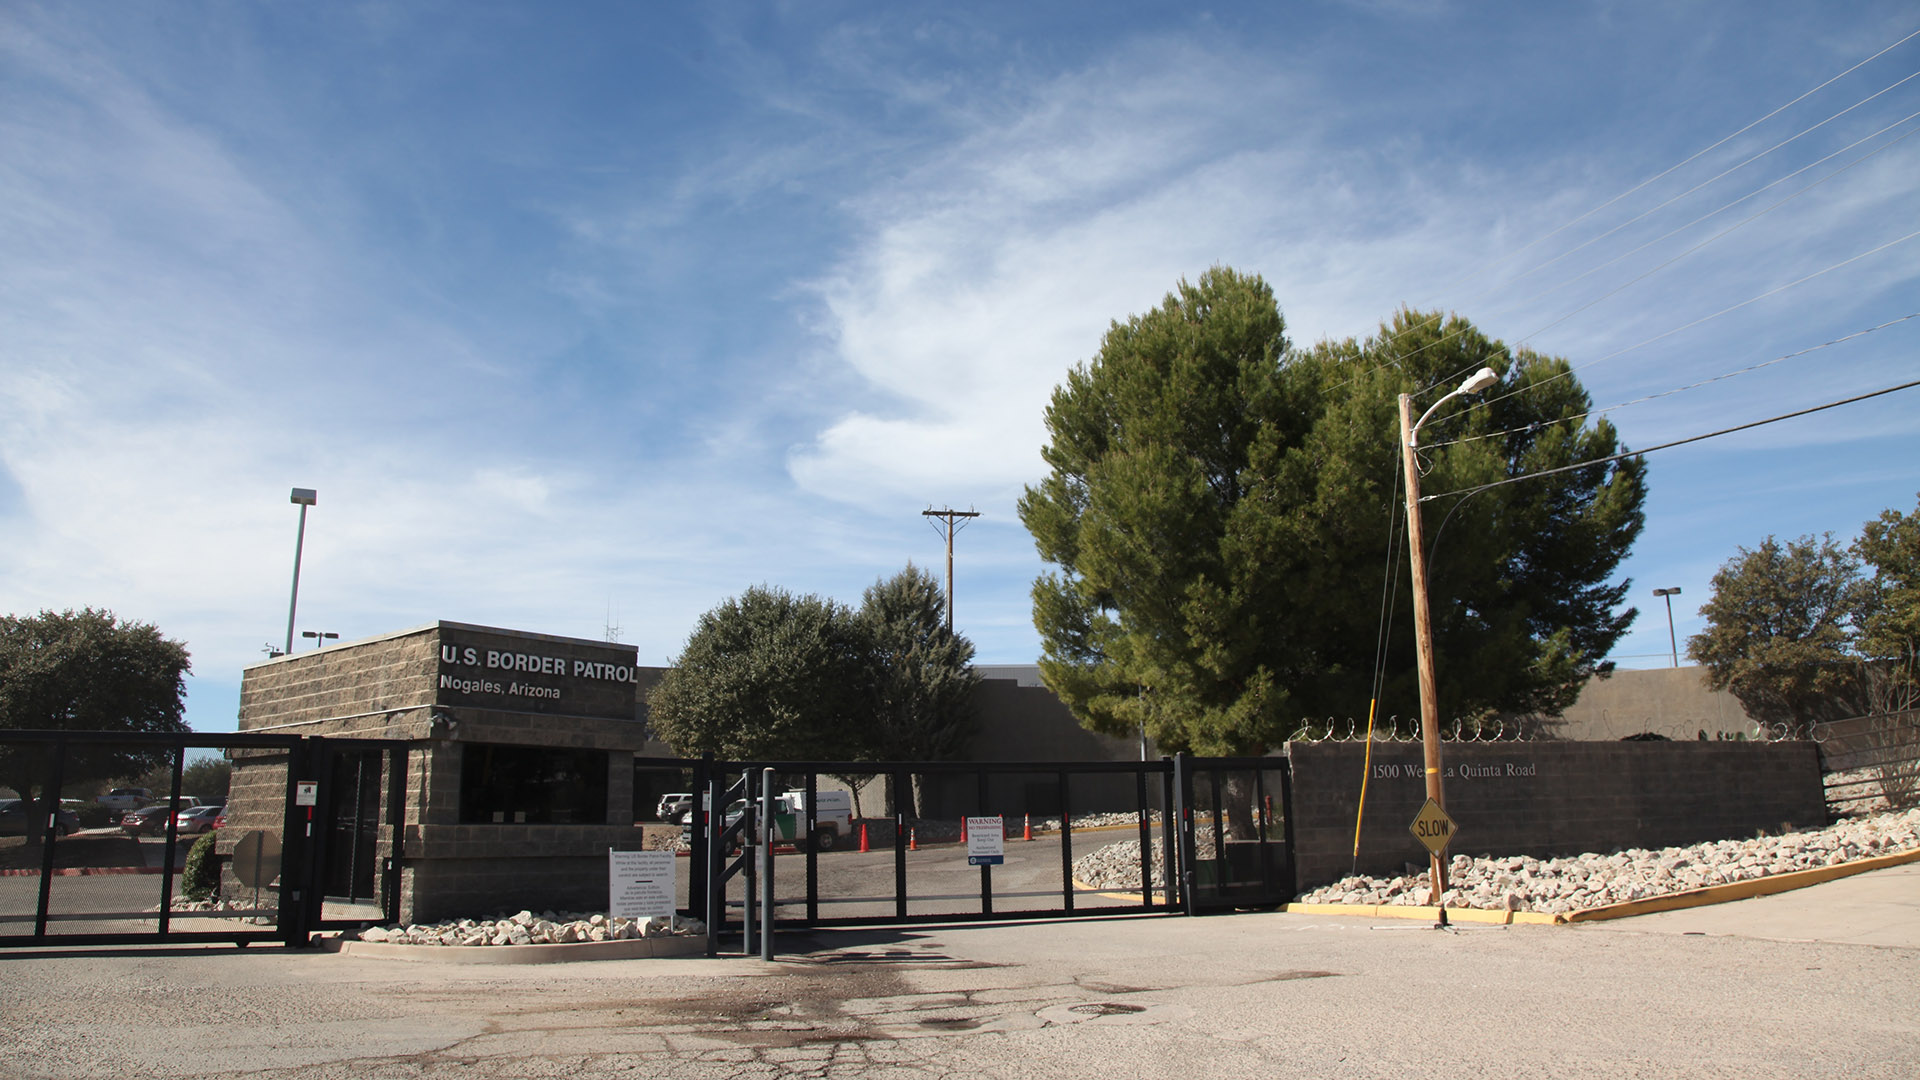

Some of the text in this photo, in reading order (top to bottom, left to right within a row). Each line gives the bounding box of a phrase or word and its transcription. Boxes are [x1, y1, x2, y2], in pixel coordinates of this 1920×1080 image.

[442, 645, 639, 683] U.S. BORDER PATROL
[440, 674, 561, 699] Nogales, Arizona
[1373, 764, 1400, 779] 1500
[1459, 763, 1501, 779] Quinta
[1506, 763, 1537, 776] Road
[1418, 819, 1449, 837] SLOW
